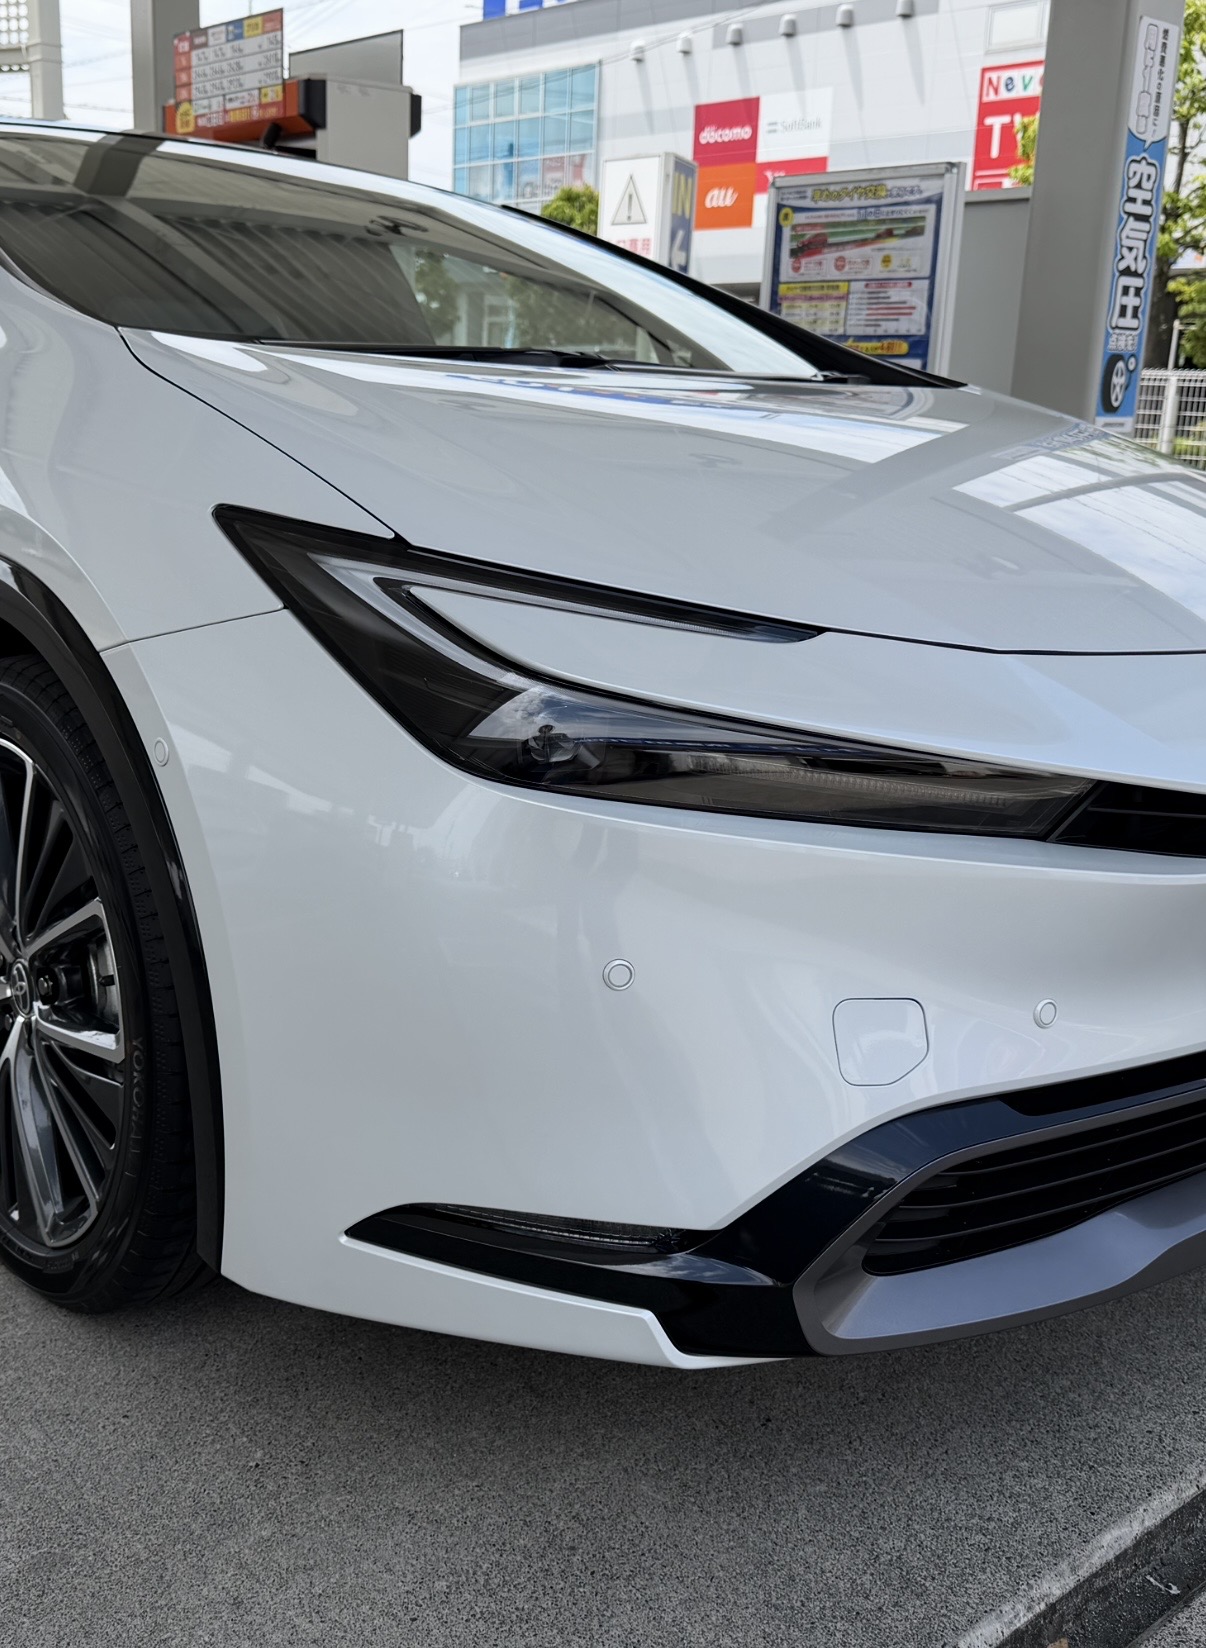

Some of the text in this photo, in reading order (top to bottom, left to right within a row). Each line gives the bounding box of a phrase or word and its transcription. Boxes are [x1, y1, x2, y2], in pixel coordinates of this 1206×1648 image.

[699, 124, 753, 145] docomo
[671, 172, 693, 218] IN
[704, 186, 739, 209] au
